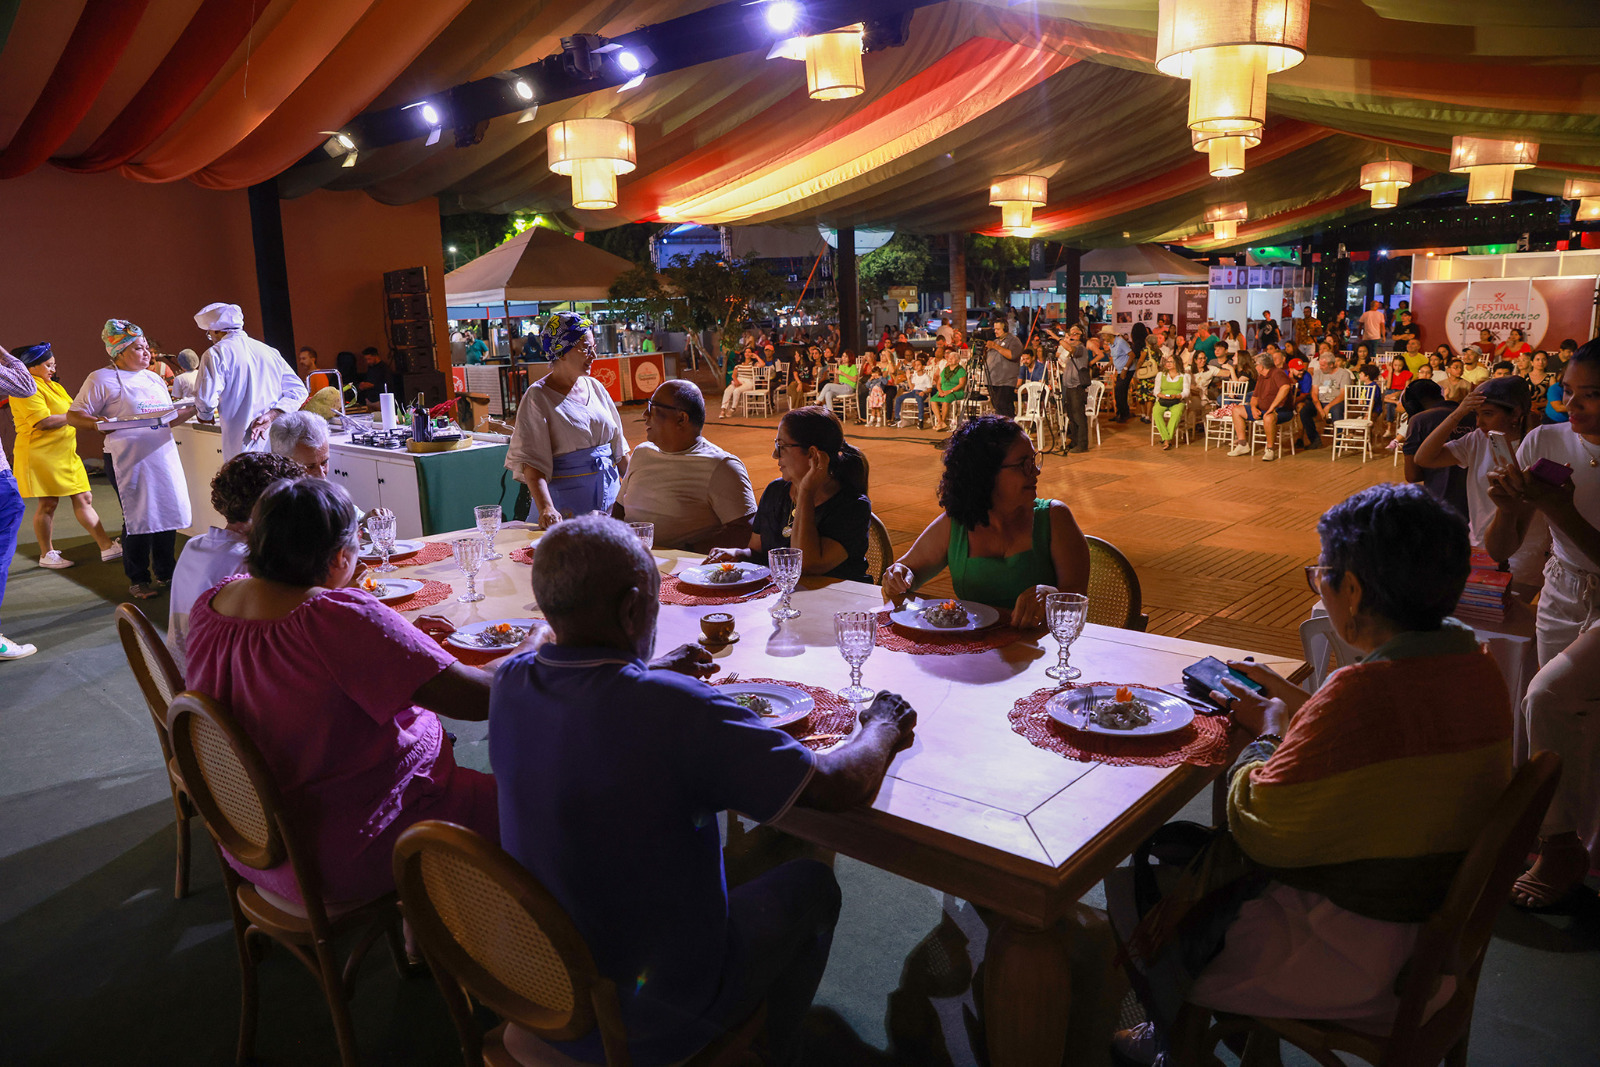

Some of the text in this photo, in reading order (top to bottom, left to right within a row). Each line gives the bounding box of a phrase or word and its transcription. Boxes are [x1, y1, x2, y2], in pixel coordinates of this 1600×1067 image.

[1062, 274, 1118, 288] LAPA
[1476, 303, 1520, 311] FESTIVAL
[1454, 307, 1540, 323] Gastronômco
